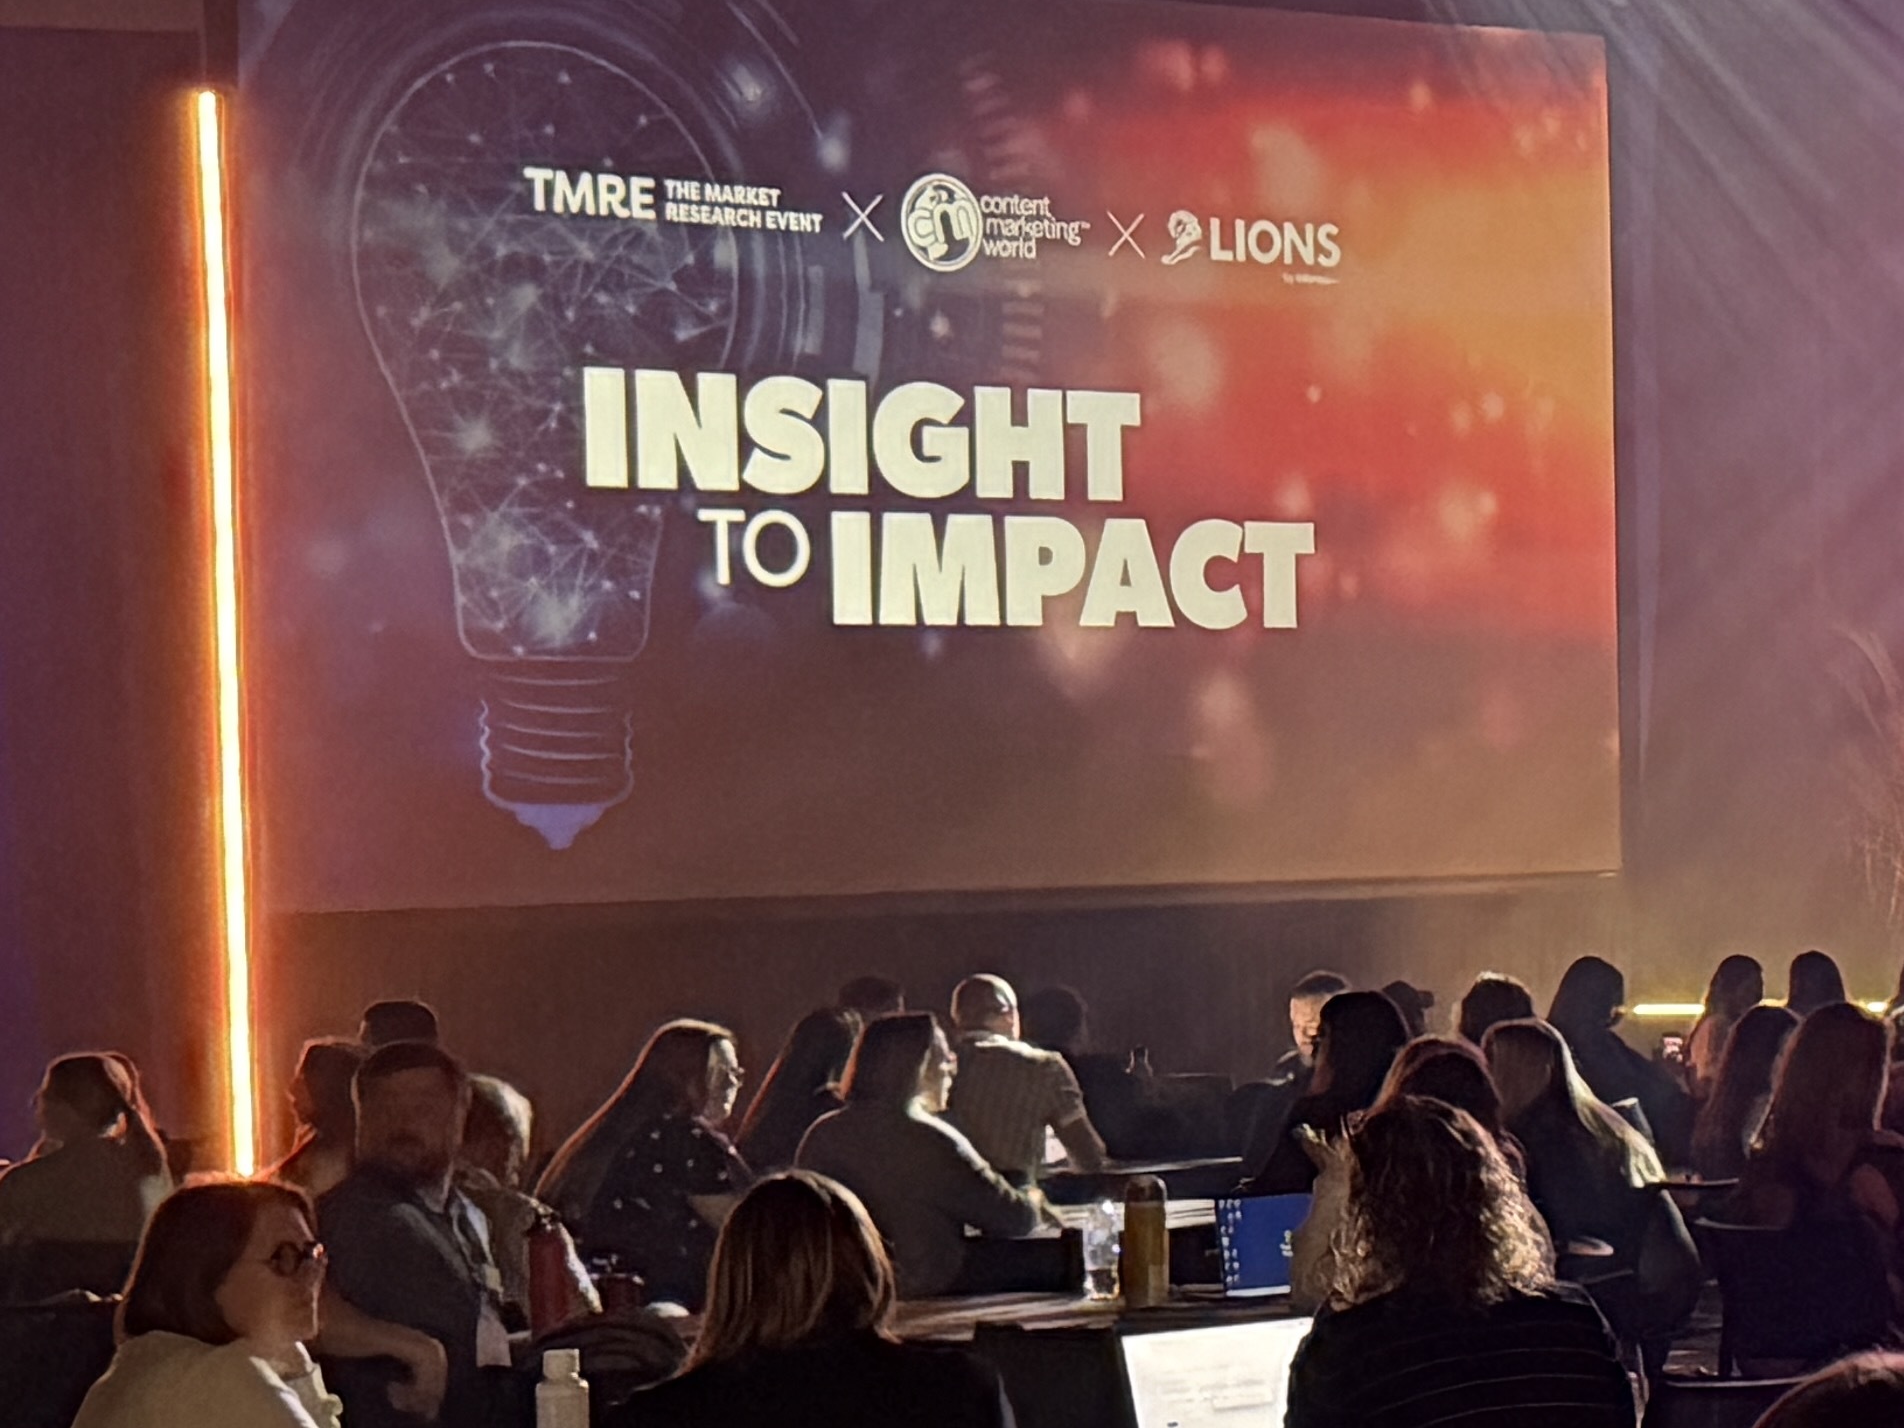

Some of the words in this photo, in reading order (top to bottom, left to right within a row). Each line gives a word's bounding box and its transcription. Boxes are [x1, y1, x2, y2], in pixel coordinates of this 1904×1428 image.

[522, 165, 657, 221] TMRE
[664, 178, 702, 203] THE
[704, 182, 782, 208] MARKET
[980, 194, 1051, 217] content
[665, 201, 763, 229] RESEARCH
[765, 210, 823, 234] EVENT
[982, 237, 1037, 259] world
[1209, 216, 1342, 268] LIONS
[583, 365, 1142, 502] INSIGHT
[698, 507, 811, 588] TO
[830, 510, 1316, 630] IMPACT
